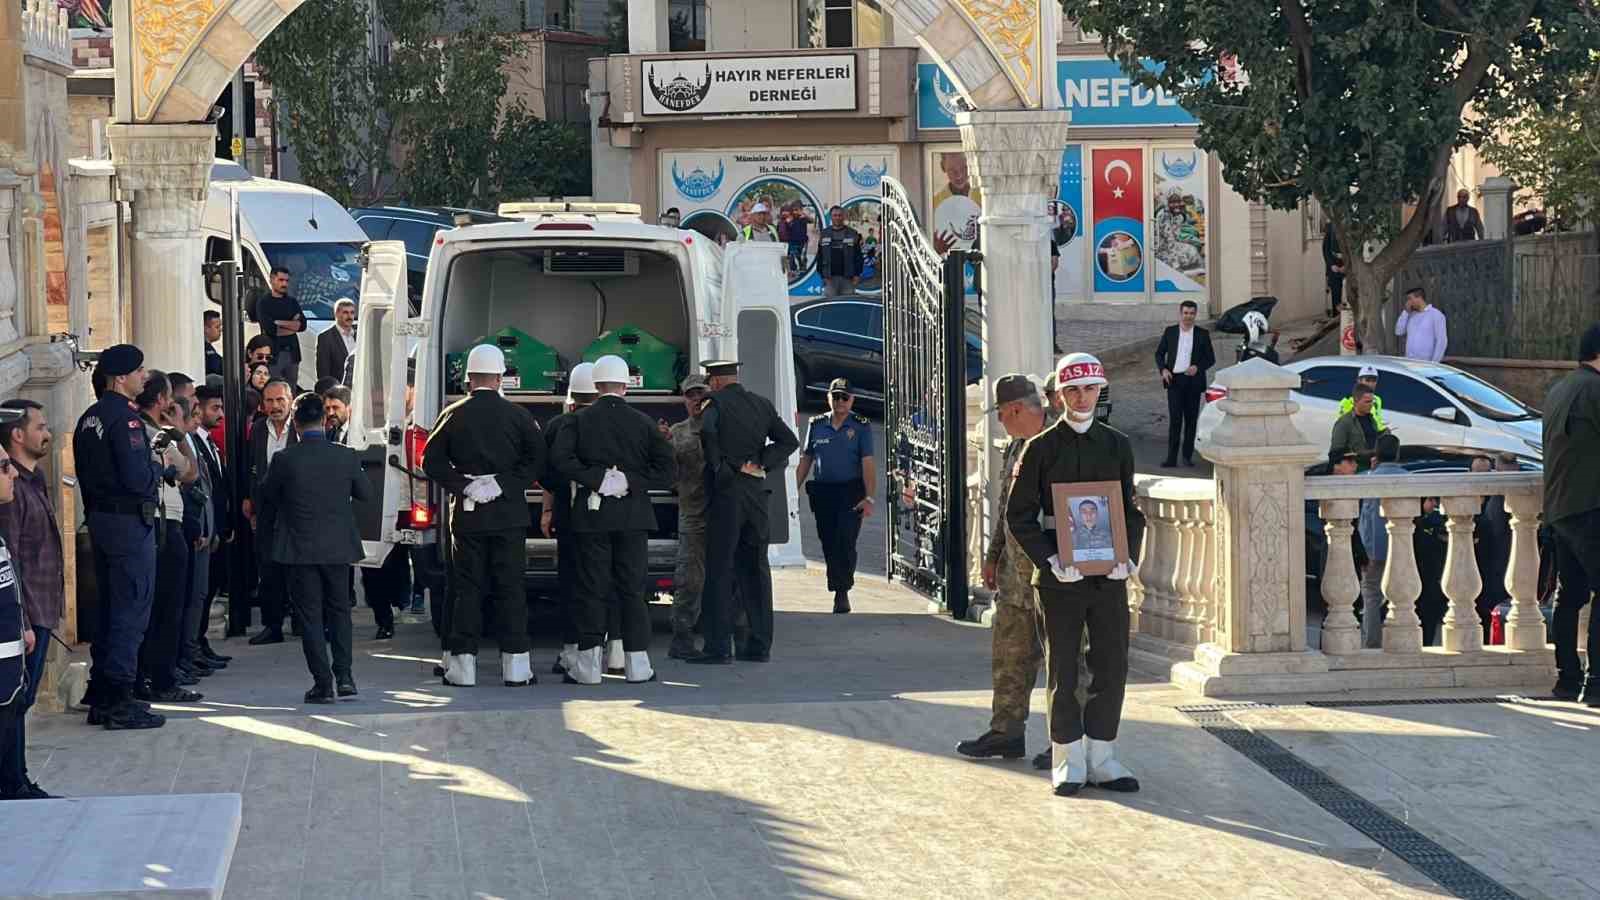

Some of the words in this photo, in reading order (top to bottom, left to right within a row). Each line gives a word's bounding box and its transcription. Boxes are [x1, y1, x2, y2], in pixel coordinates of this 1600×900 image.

[716, 68, 761, 83] HAYIR
[766, 64, 850, 81] NEFERLERİ
[750, 86, 817, 102] DERNEĞİ
